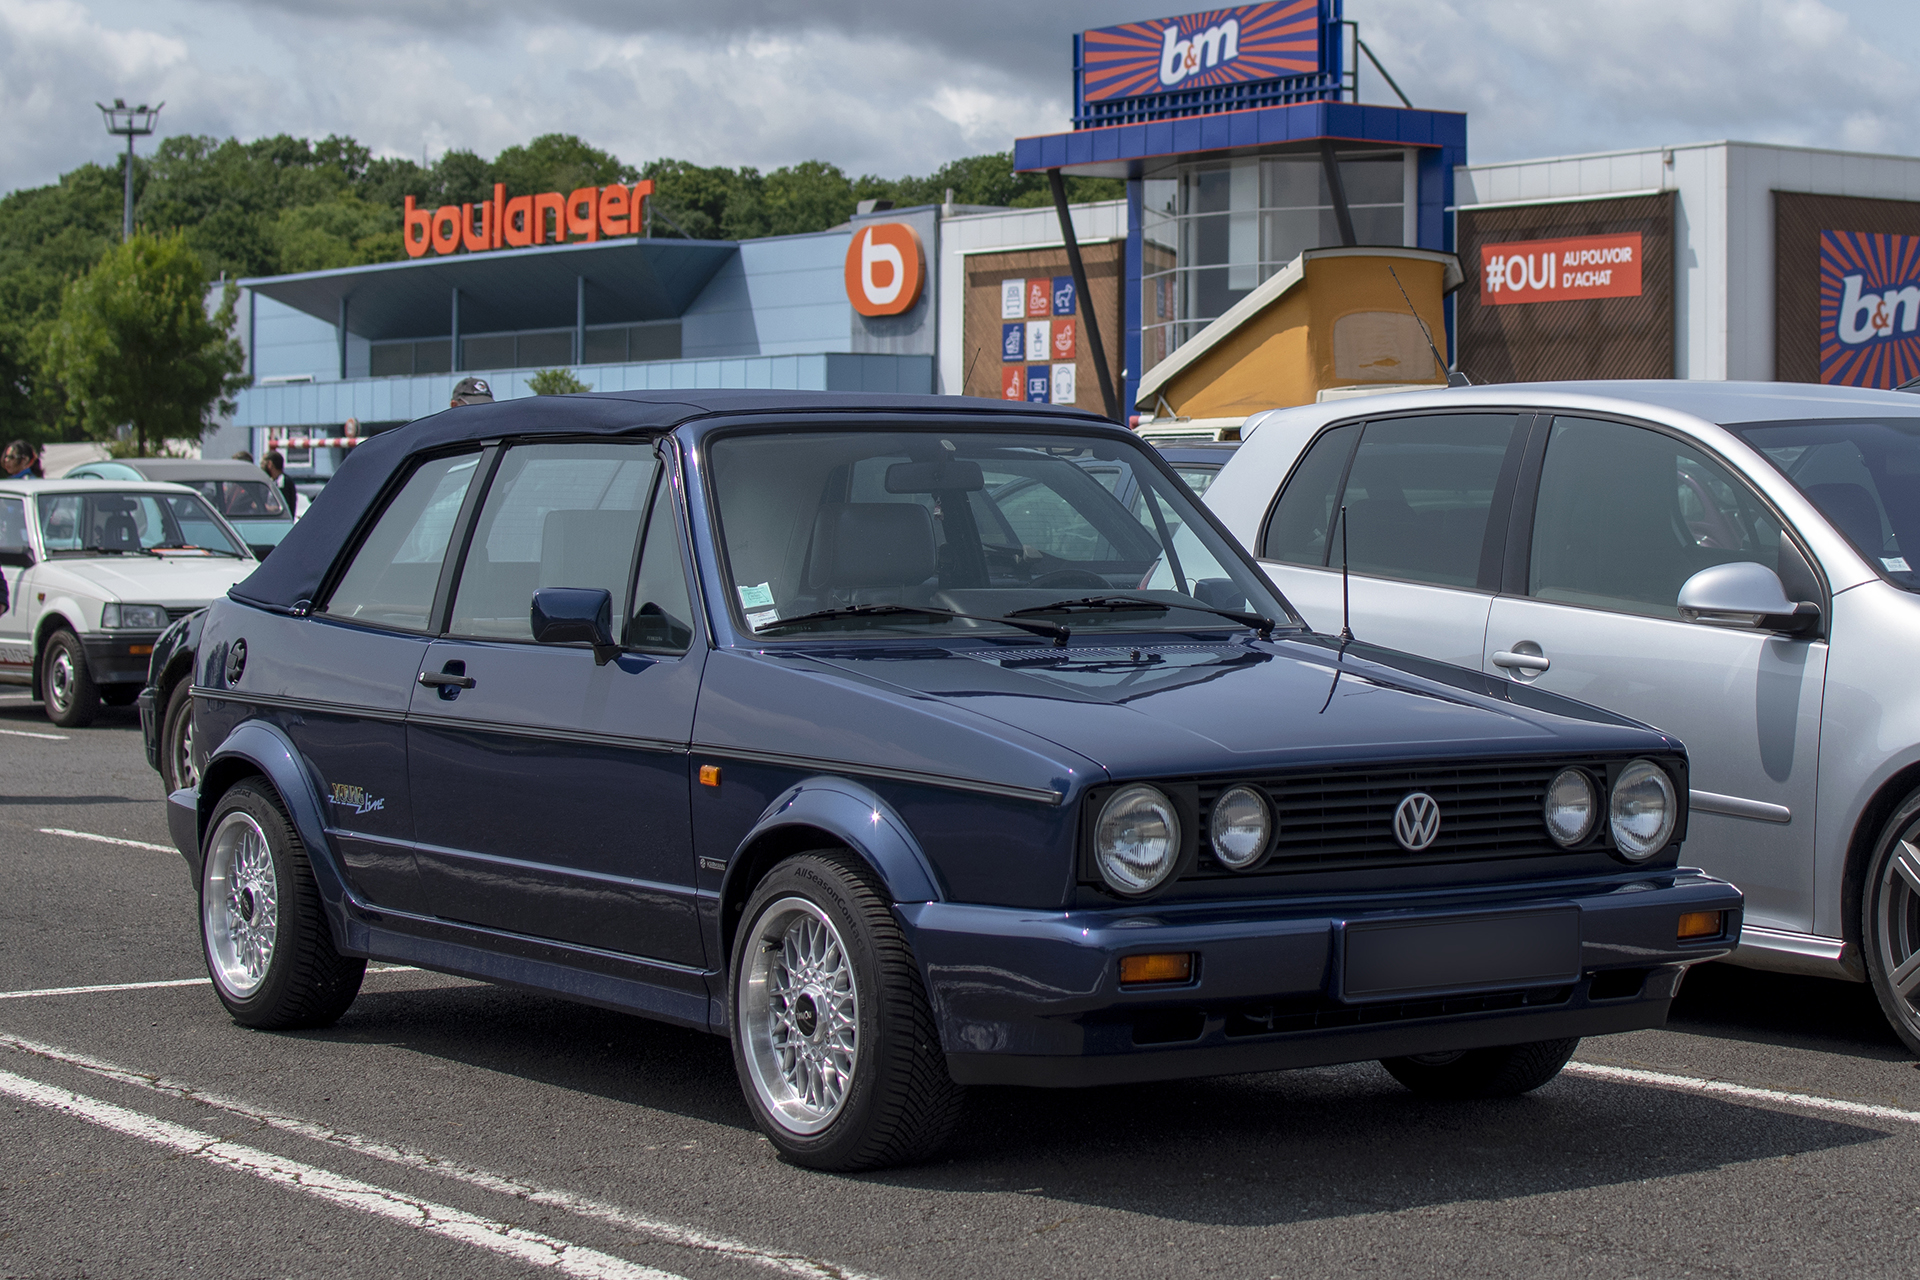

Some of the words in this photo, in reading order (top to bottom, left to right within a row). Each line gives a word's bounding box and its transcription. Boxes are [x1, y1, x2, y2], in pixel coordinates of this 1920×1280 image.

[1159, 18, 1240, 86] b&m
[404, 180, 655, 257] boulanger
[861, 227, 904, 305] b
[1486, 252, 1556, 293] #OUI
[1562, 251, 1579, 267] AU
[1581, 246, 1632, 265] POUVOIR
[1562, 270, 1612, 288] D'ACHAT
[794, 867, 866, 953] AllSeasonContact
